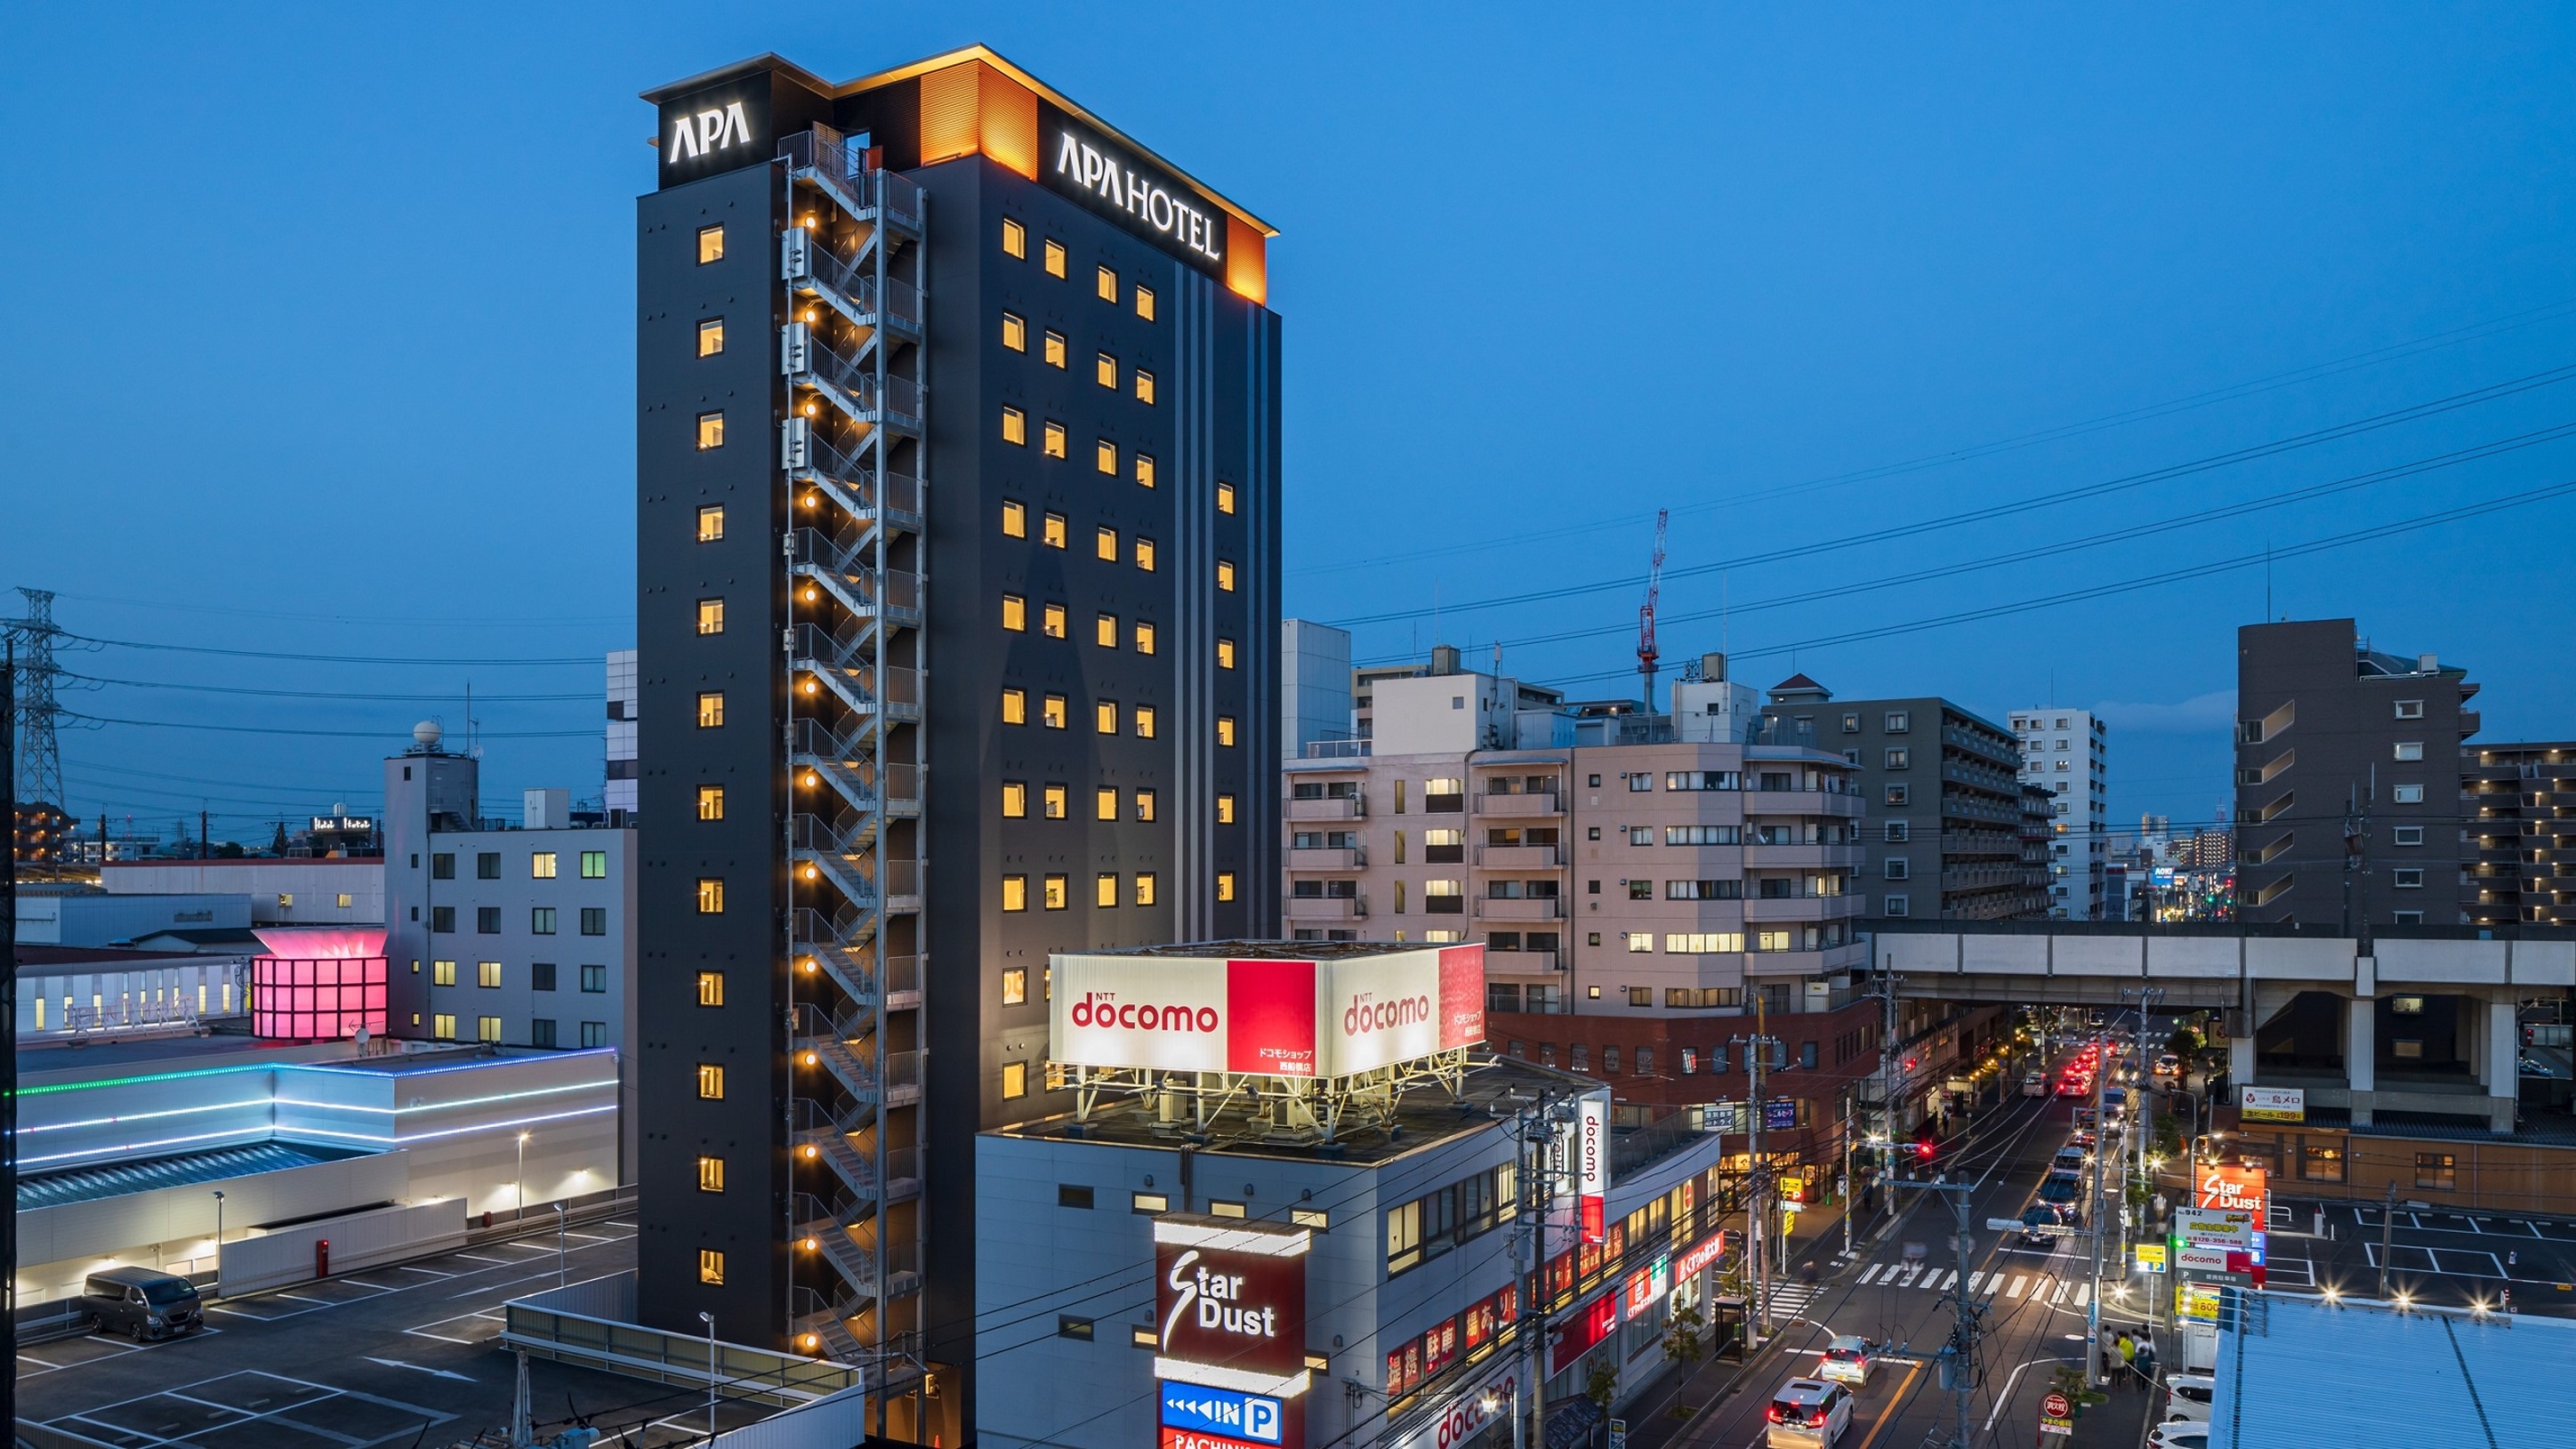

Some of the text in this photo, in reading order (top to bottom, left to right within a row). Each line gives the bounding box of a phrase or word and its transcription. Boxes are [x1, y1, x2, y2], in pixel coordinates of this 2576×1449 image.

[669, 100, 751, 164] APA
[1057, 132, 1220, 261] APA HOTEL
[2155, 867, 2173, 876] AOKI
[1095, 991, 1116, 1001] NTT
[1359, 991, 1373, 1003] NTT
[1072, 991, 1218, 1033] docomo
[1344, 993, 1429, 1037] docomo
[1260, 1047, 1312, 1060] ドコモショップ
[1586, 1115, 1599, 1182] docomo
[2201, 1173, 2245, 1209] Star
[2219, 1193, 2262, 1210] Dust
[2153, 1262, 2162, 1272] P
[2181, 1253, 2222, 1264] docomo
[1163, 1250, 1245, 1355] Star
[1198, 1297, 1276, 1338] Dust
[1215, 1399, 1240, 1426] IN
